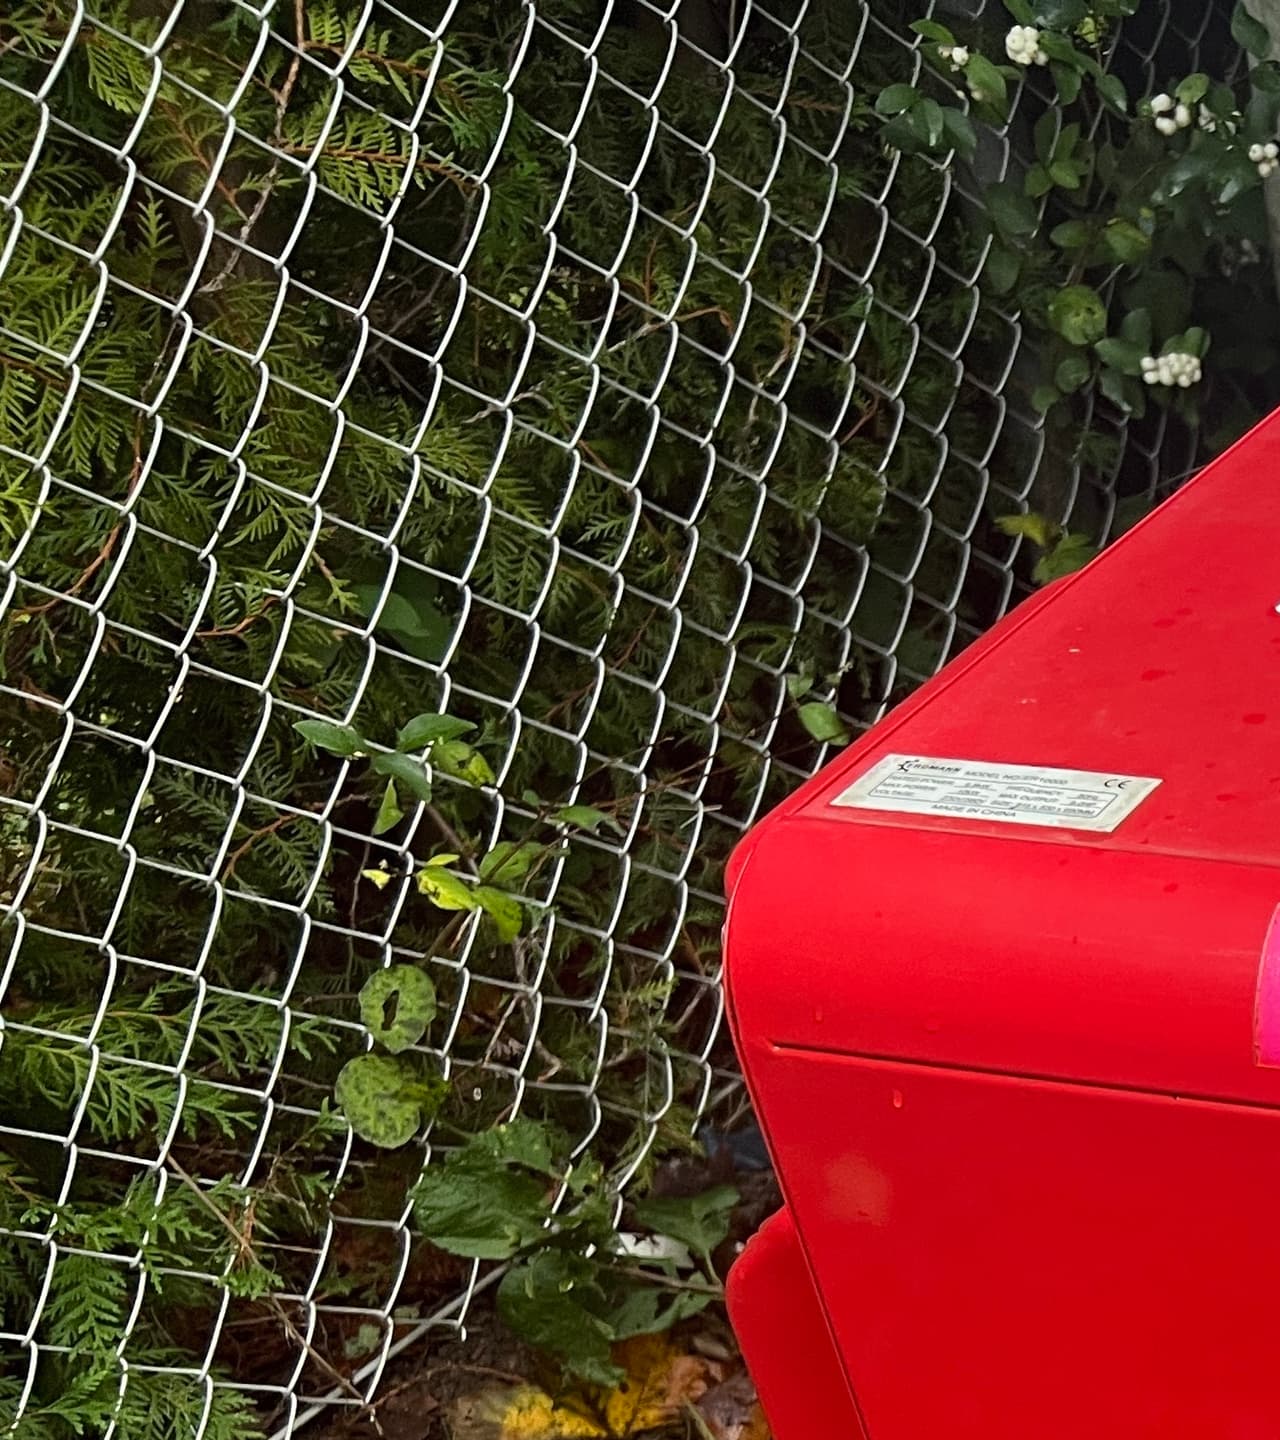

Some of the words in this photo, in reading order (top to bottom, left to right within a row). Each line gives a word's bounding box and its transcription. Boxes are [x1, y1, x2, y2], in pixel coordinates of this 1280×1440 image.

[1103, 778, 1131, 790] CE
[931, 803, 960, 814] MADE
[967, 806, 979, 817] IN
[980, 808, 1017, 818] CHINA
